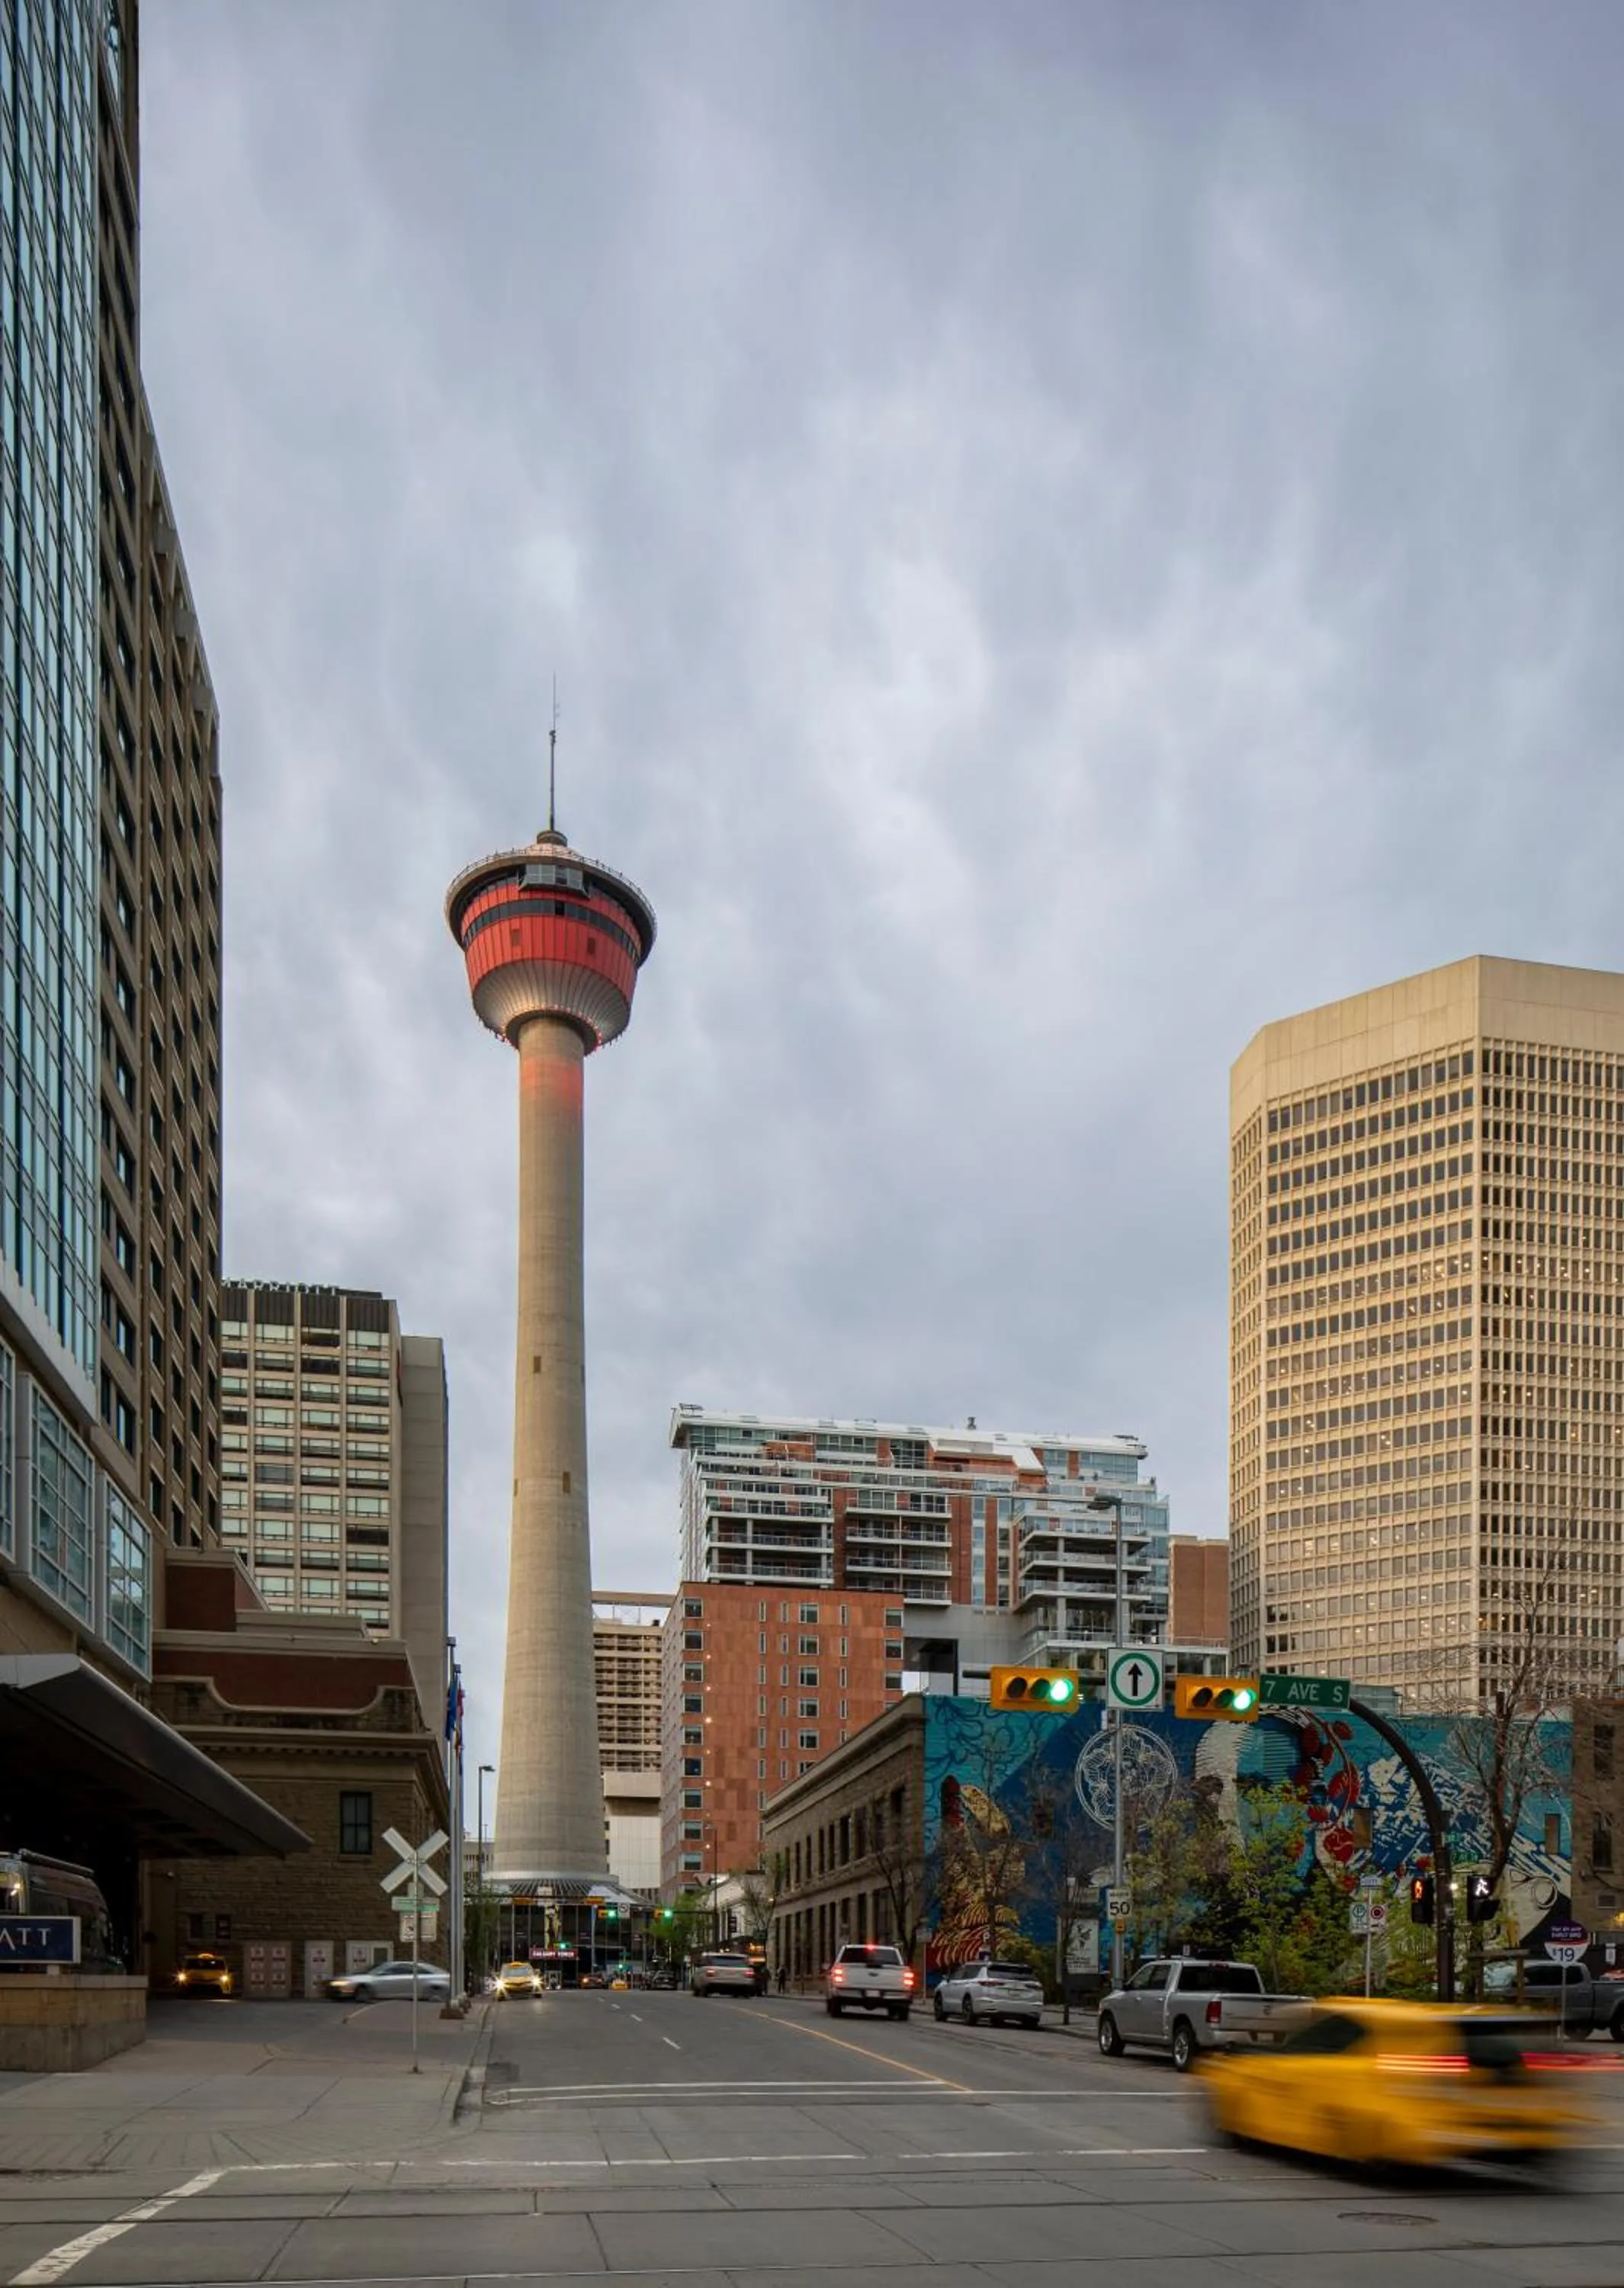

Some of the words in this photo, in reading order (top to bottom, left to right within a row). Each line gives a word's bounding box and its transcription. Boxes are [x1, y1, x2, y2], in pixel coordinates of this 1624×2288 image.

[1265, 1680, 1276, 1698] 7
[1286, 1682, 1320, 1702] AVE
[1332, 1685, 1343, 1703] S
[1109, 1901, 1130, 1915] 50
